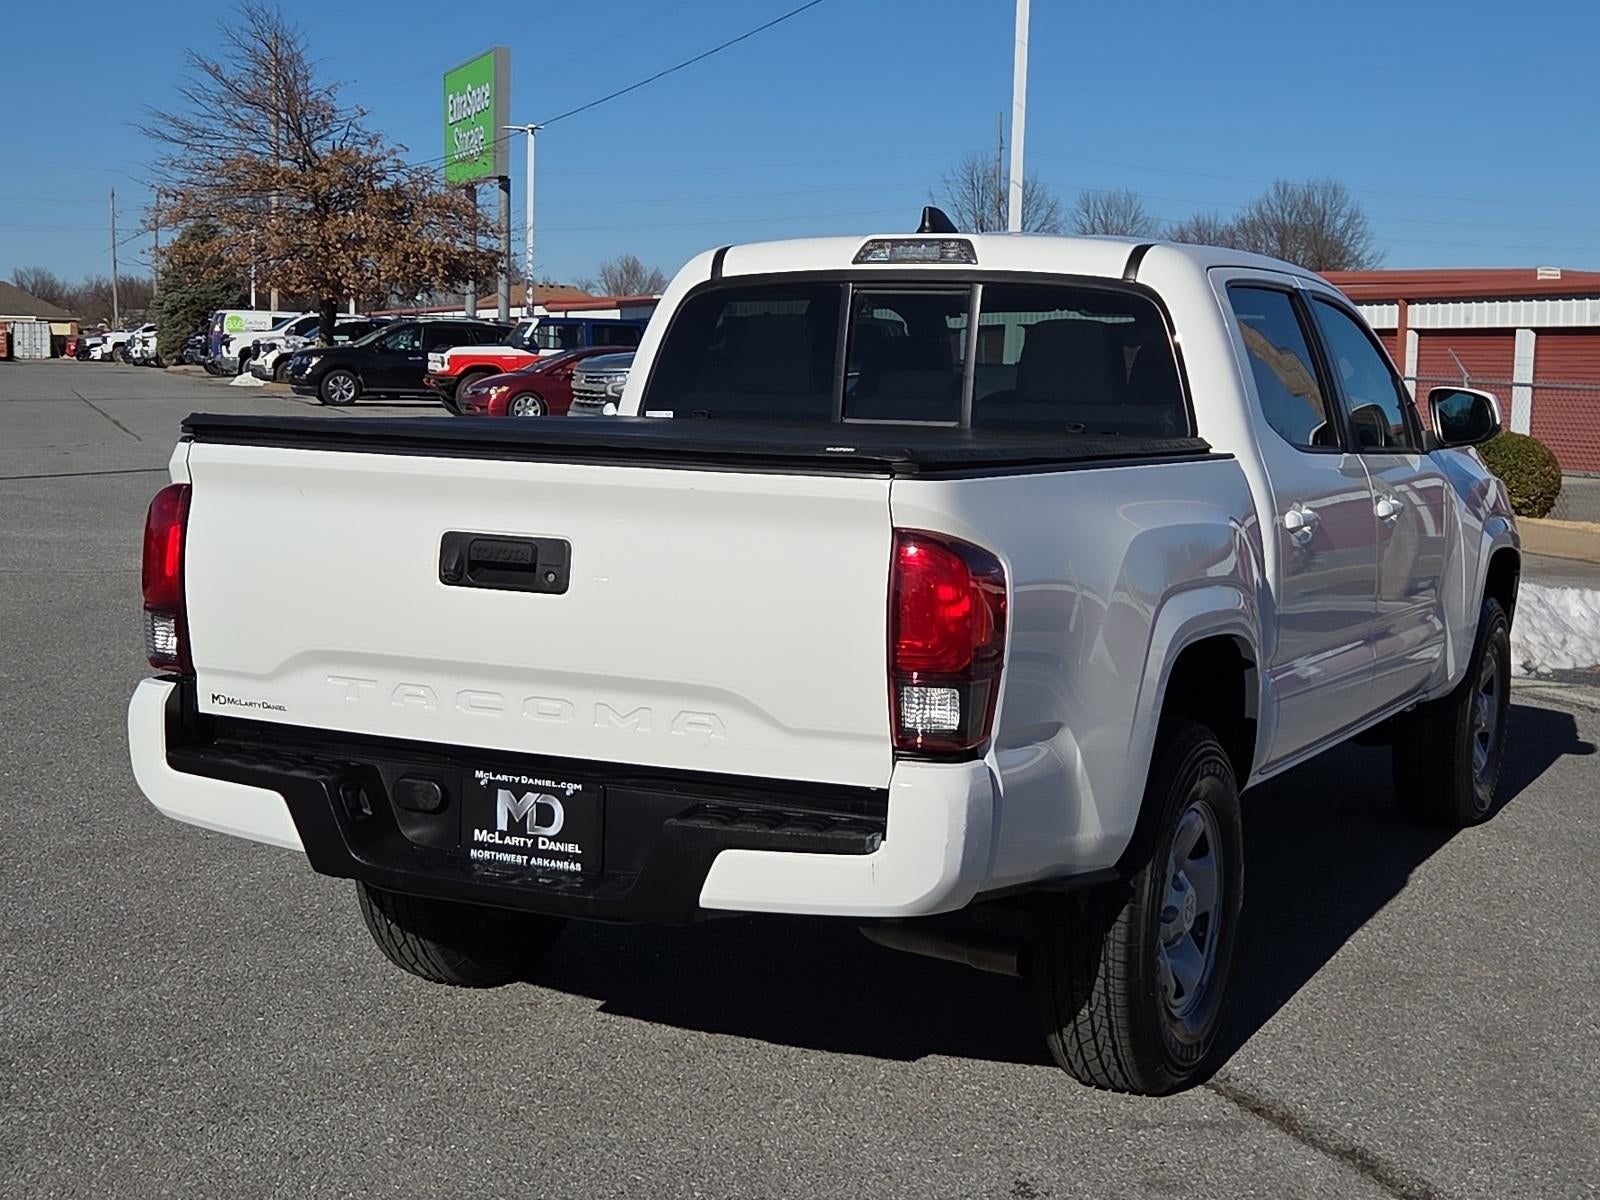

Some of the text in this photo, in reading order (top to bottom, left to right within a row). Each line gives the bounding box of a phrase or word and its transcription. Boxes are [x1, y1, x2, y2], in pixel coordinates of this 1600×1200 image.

[454, 126, 485, 160] Storage
[472, 546, 530, 561] TOYOTA
[326, 675, 727, 739] TACOMA
[496, 789, 564, 836] MD
[538, 837, 582, 854] DANIEL
[470, 849, 582, 872] NORTHWEST ARKANSAS
